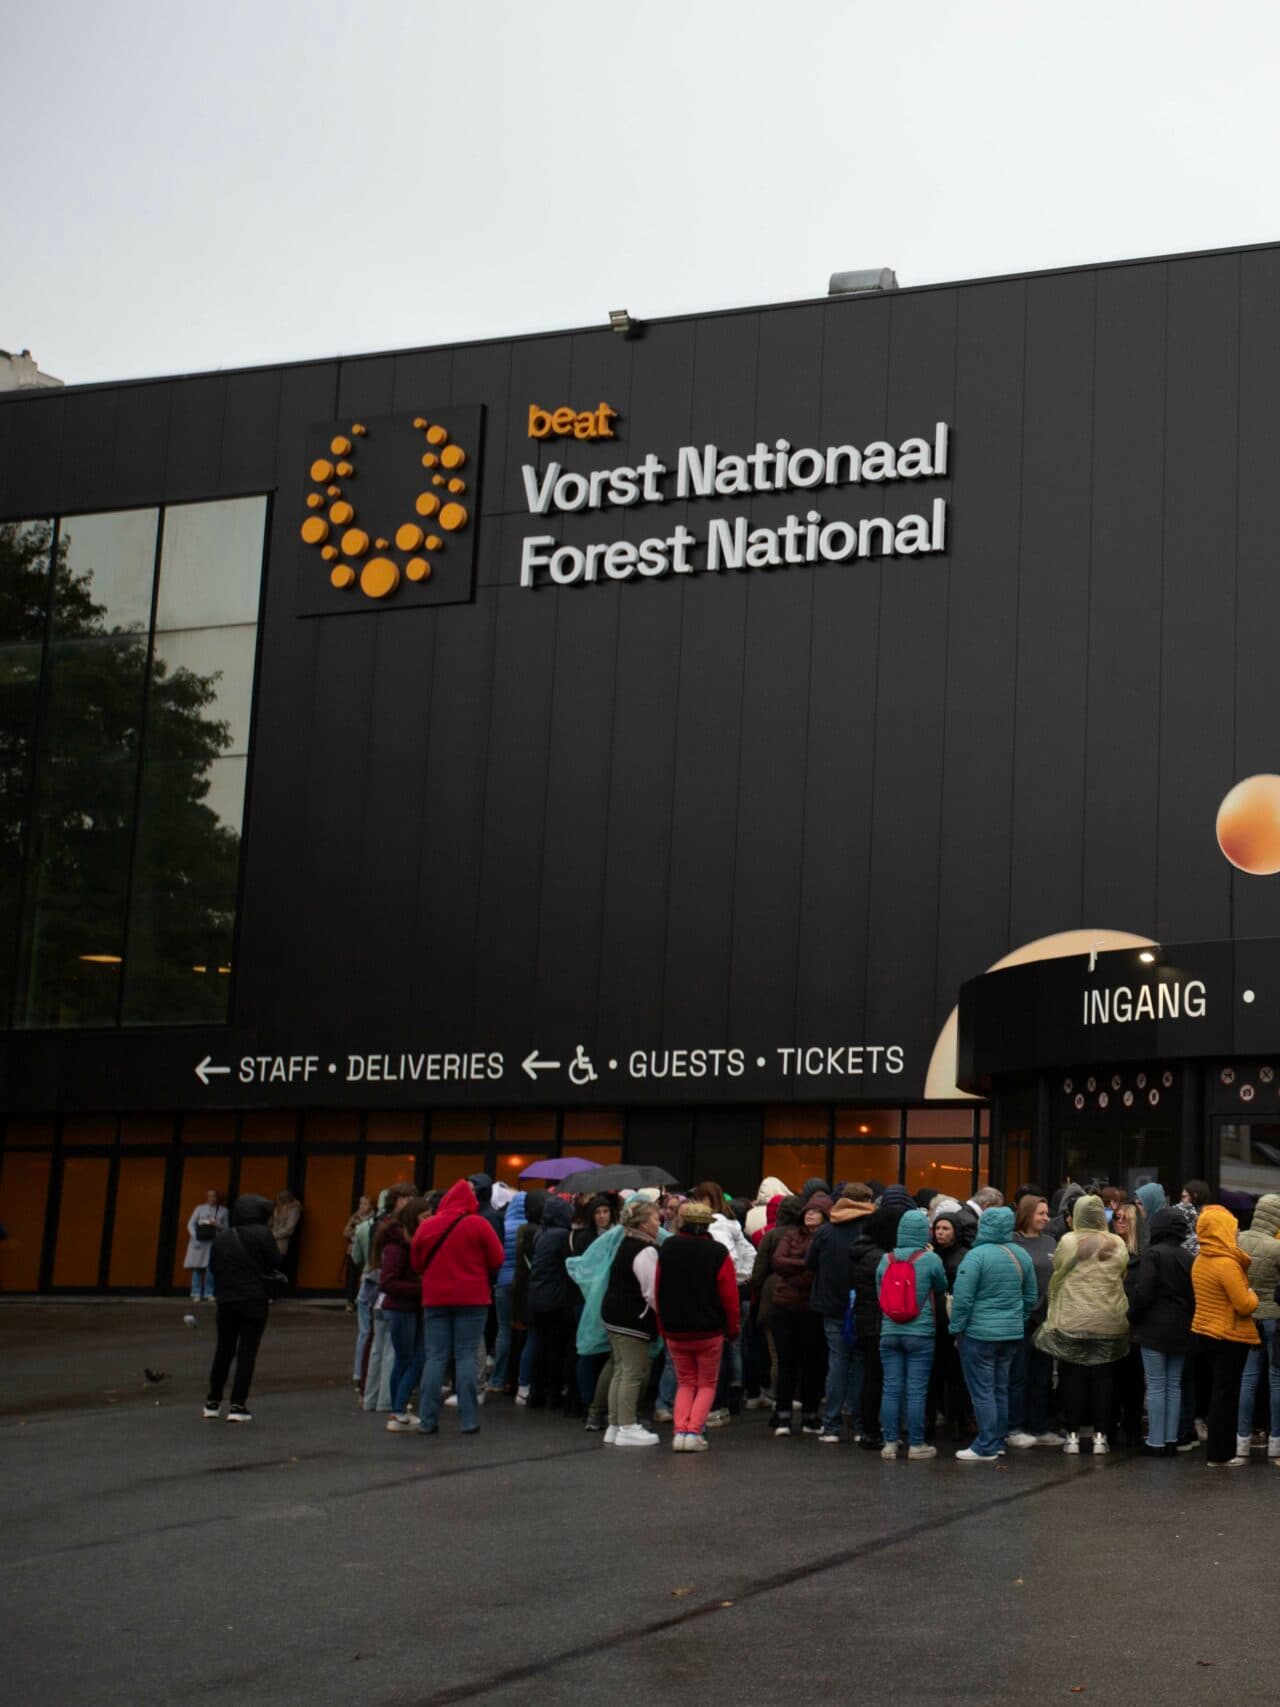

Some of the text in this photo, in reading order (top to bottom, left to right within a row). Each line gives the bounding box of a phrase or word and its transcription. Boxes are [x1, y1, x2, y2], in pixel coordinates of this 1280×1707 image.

[527, 402, 615, 439] beat
[522, 422, 948, 513] Vorst Nationaal
[521, 498, 946, 587] Forest National
[1083, 980, 1207, 1025] INGANG
[238, 1051, 504, 1083] STAFF DELIVERIES
[628, 1045, 905, 1079] GUESTS TICKETS
